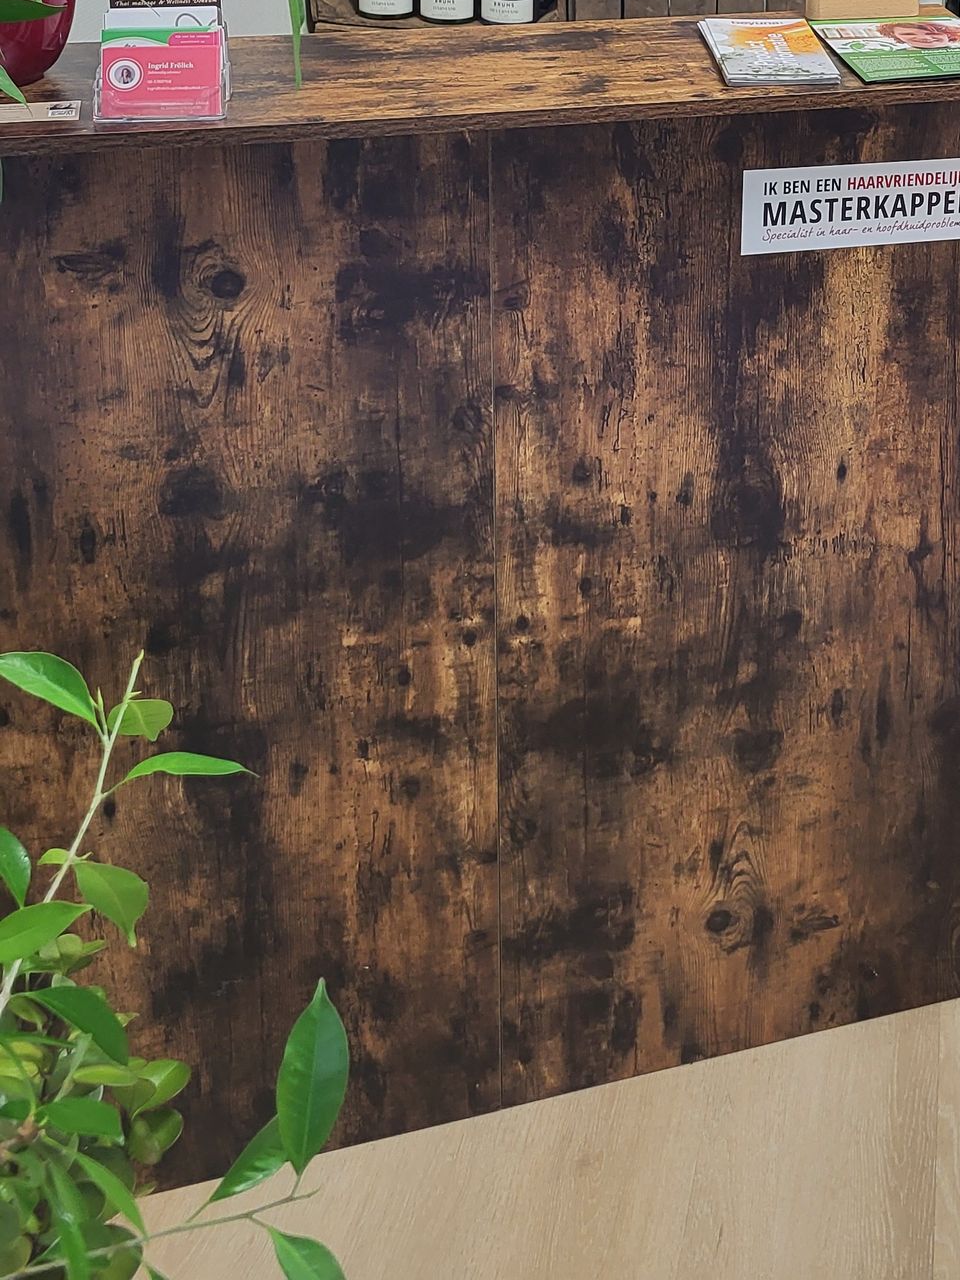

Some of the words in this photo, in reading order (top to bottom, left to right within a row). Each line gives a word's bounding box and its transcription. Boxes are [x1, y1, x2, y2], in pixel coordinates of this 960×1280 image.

[148, 62, 169, 71] Ingrid
[170, 61, 194, 69] Frölich
[763, 181, 778, 196] IK
[783, 179, 811, 195] BEN
[816, 178, 842, 192] EEN
[761, 224, 814, 242] Specialist
[816, 226, 826, 237] in
[828, 224, 859, 236] haar-
[861, 225, 873, 234] en
